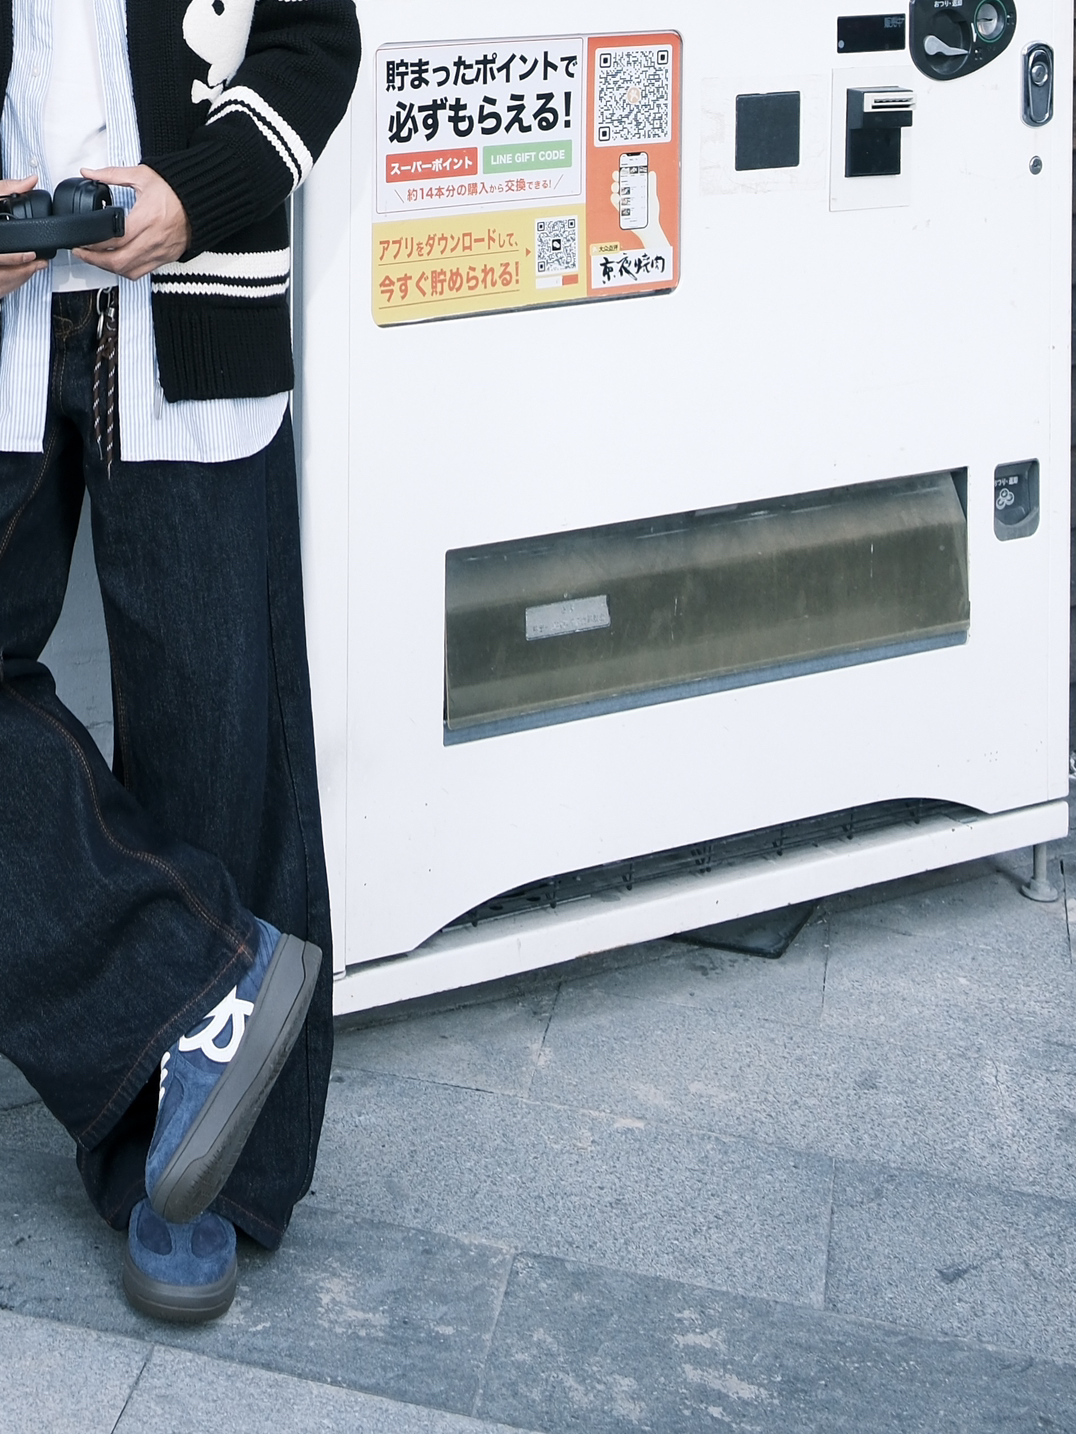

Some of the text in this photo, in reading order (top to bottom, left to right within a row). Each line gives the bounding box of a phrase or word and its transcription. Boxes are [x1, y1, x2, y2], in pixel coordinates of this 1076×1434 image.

[385, 51, 578, 92] 貯まったポイントで
[387, 91, 572, 144] 必ずもらえる!
[390, 156, 473, 176] スーパーポイント
[491, 150, 565, 165] LINE GIFT CODE
[379, 261, 520, 303] 今すぐ貯められる!
